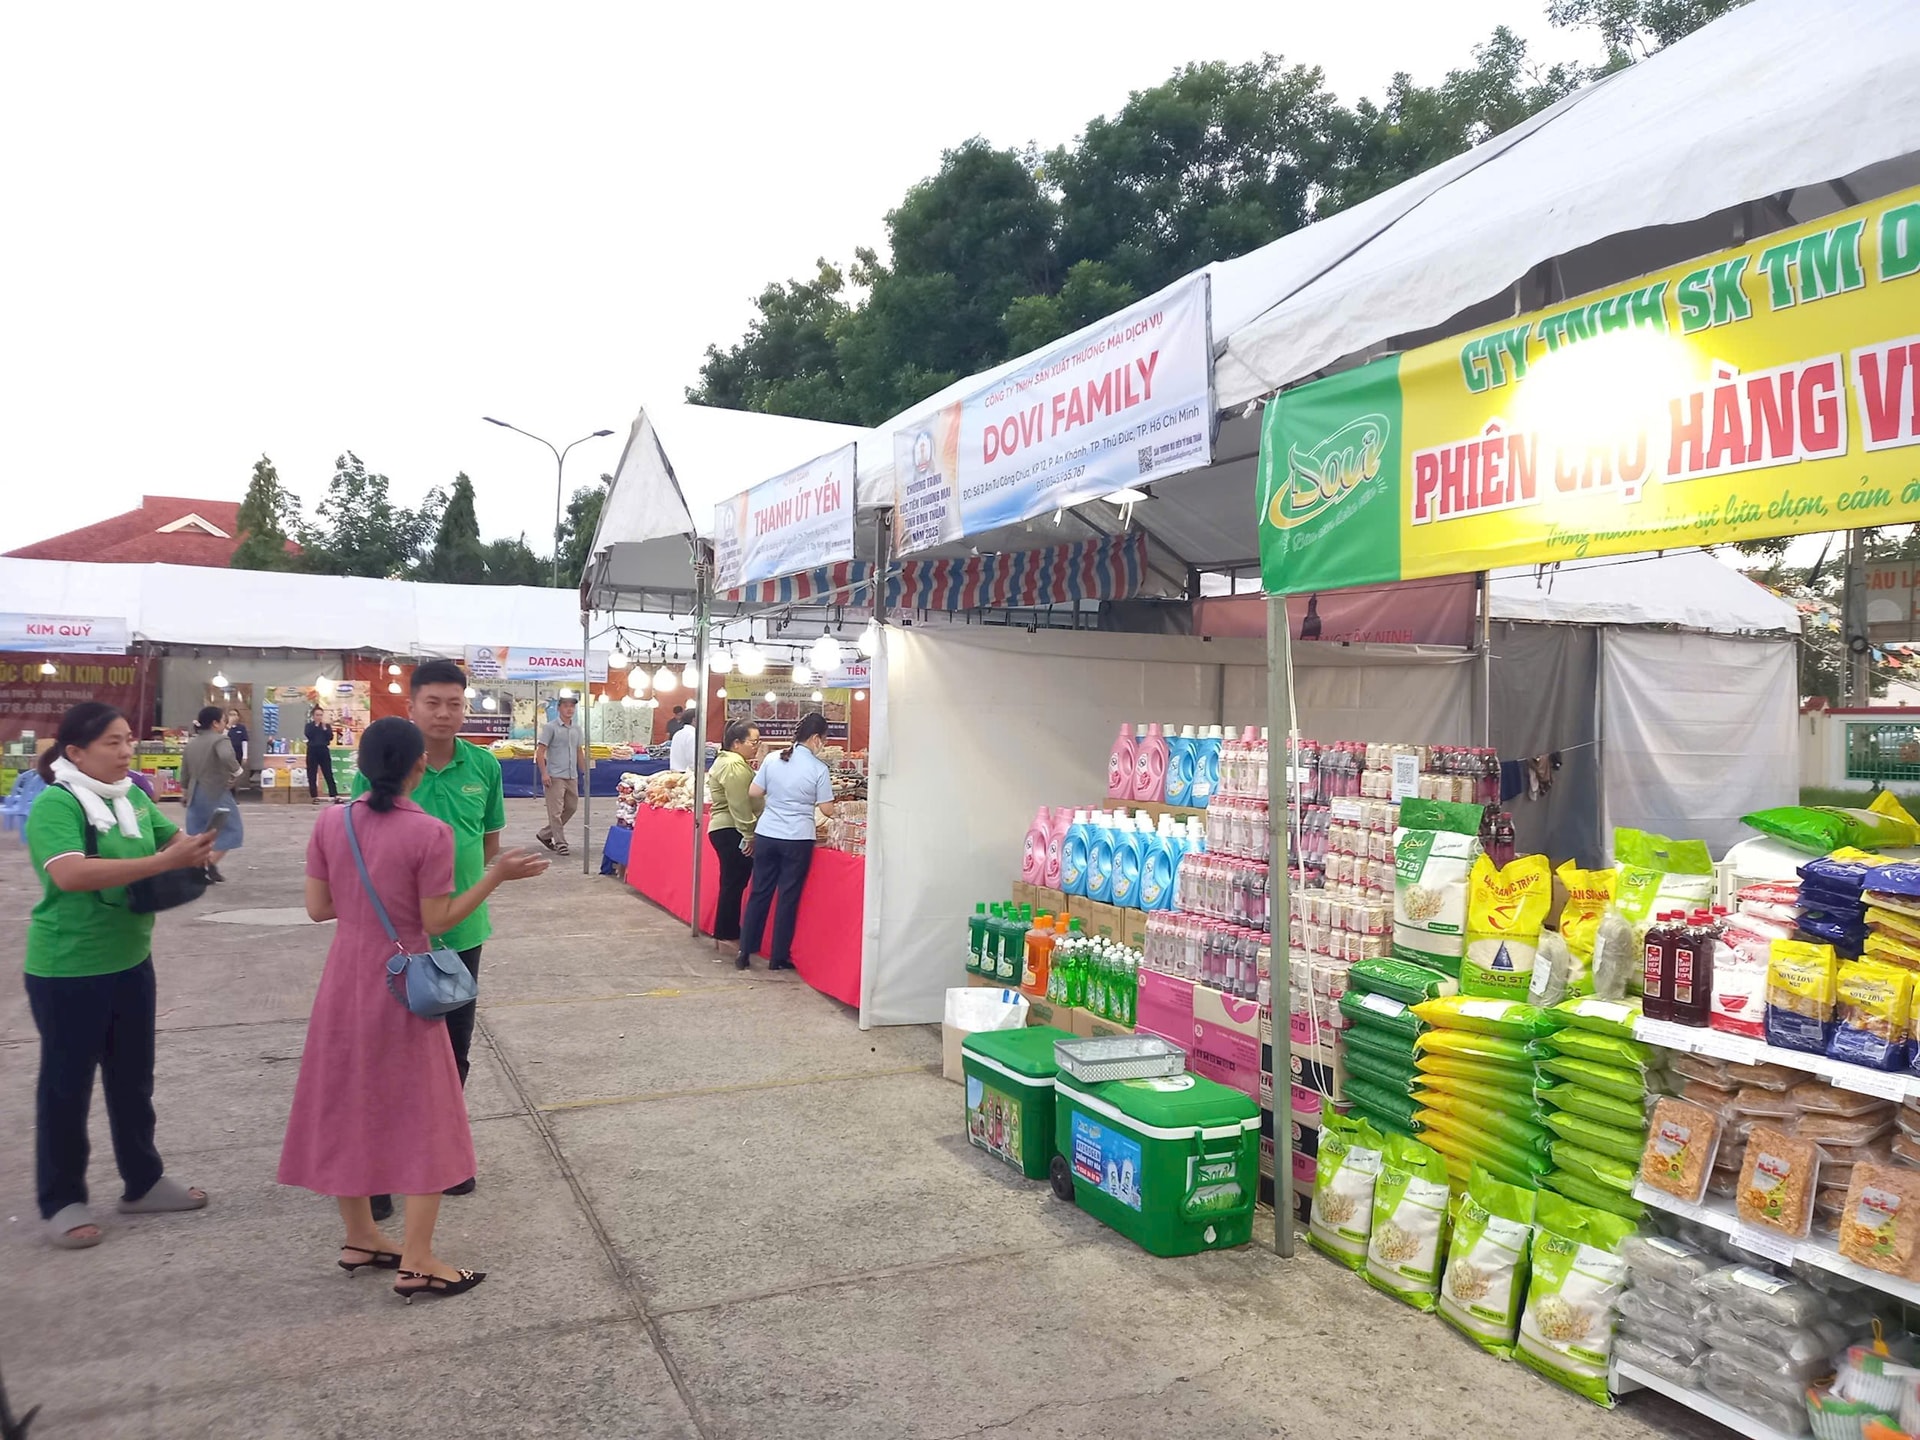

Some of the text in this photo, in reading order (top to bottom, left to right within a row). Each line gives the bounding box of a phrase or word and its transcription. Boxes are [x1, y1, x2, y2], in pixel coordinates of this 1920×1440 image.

[1461, 323, 1533, 393] CTY
[1676, 255, 1752, 334] SX
[1757, 217, 1867, 311] TM
[985, 392, 1004, 408] CÔNG
[1034, 368, 1050, 385] SẢN
[1051, 356, 1070, 374] XUẤT
[1072, 341, 1106, 366] THƯƠNG
[1107, 334, 1124, 350] MẠI
[1125, 323, 1148, 342] DỊCH
[1149, 312, 1163, 330] VỤ
[983, 350, 1159, 465] DOVI FAMILY
[1103, 432, 1117, 450] Thủ
[1118, 429, 1136, 446] Đức,
[1137, 425, 1149, 438] TP.
[1150, 418, 1161, 434] Hồ
[1163, 411, 1177, 429] Chí
[1179, 405, 1200, 423] Minh
[1415, 423, 1537, 519] PHIÊN
[1668, 361, 1840, 475] HÀNG
[753, 498, 792, 537] THANH
[795, 487, 811, 522] ÚT
[814, 472, 841, 517] YẾN
[1837, 475, 1893, 511] cảm
[26, 623, 54, 635] KIM
[528, 656, 585, 668] DATASAN
[1395, 859, 1420, 872] ST25
